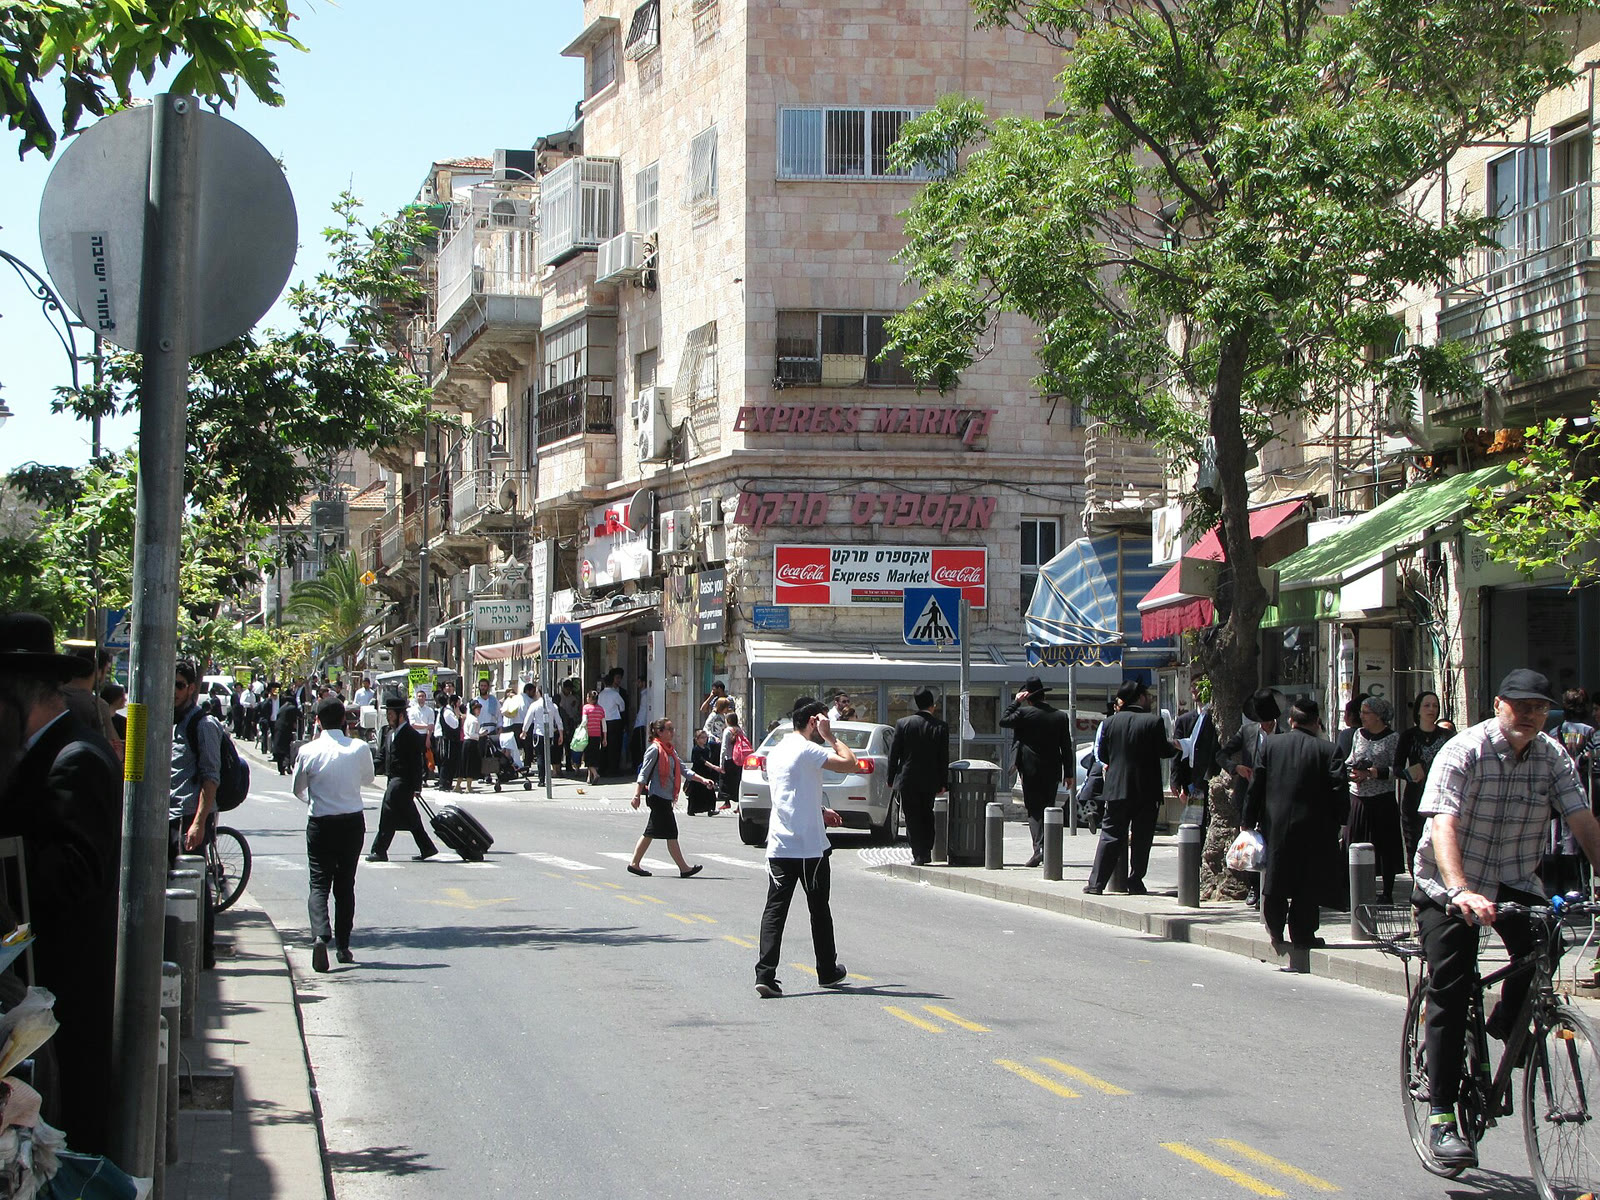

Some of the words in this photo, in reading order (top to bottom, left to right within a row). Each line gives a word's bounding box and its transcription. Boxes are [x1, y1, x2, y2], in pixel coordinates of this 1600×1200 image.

[91, 236, 106, 281] ישיבה
[97, 289, 113, 331] בחורי
[733, 406, 862, 433] EXPRESS
[873, 407, 998, 445] MARKET
[733, 493, 830, 534] מרקט
[851, 493, 998, 535] אקספרס
[831, 549, 868, 565] מרקט
[875, 550, 930, 566] אקספרס
[777, 563, 827, 580] Coca-Cola
[831, 568, 880, 585] Express
[886, 569, 930, 583] Market
[934, 565, 983, 583] Coca-Cola
[700, 578, 713, 595] basic
[714, 579, 724, 597] you
[479, 605, 511, 615] מרקחת
[515, 604, 531, 613] בית
[491, 615, 519, 624] גאולה
[1040, 646, 1101, 660] MIRYAM
